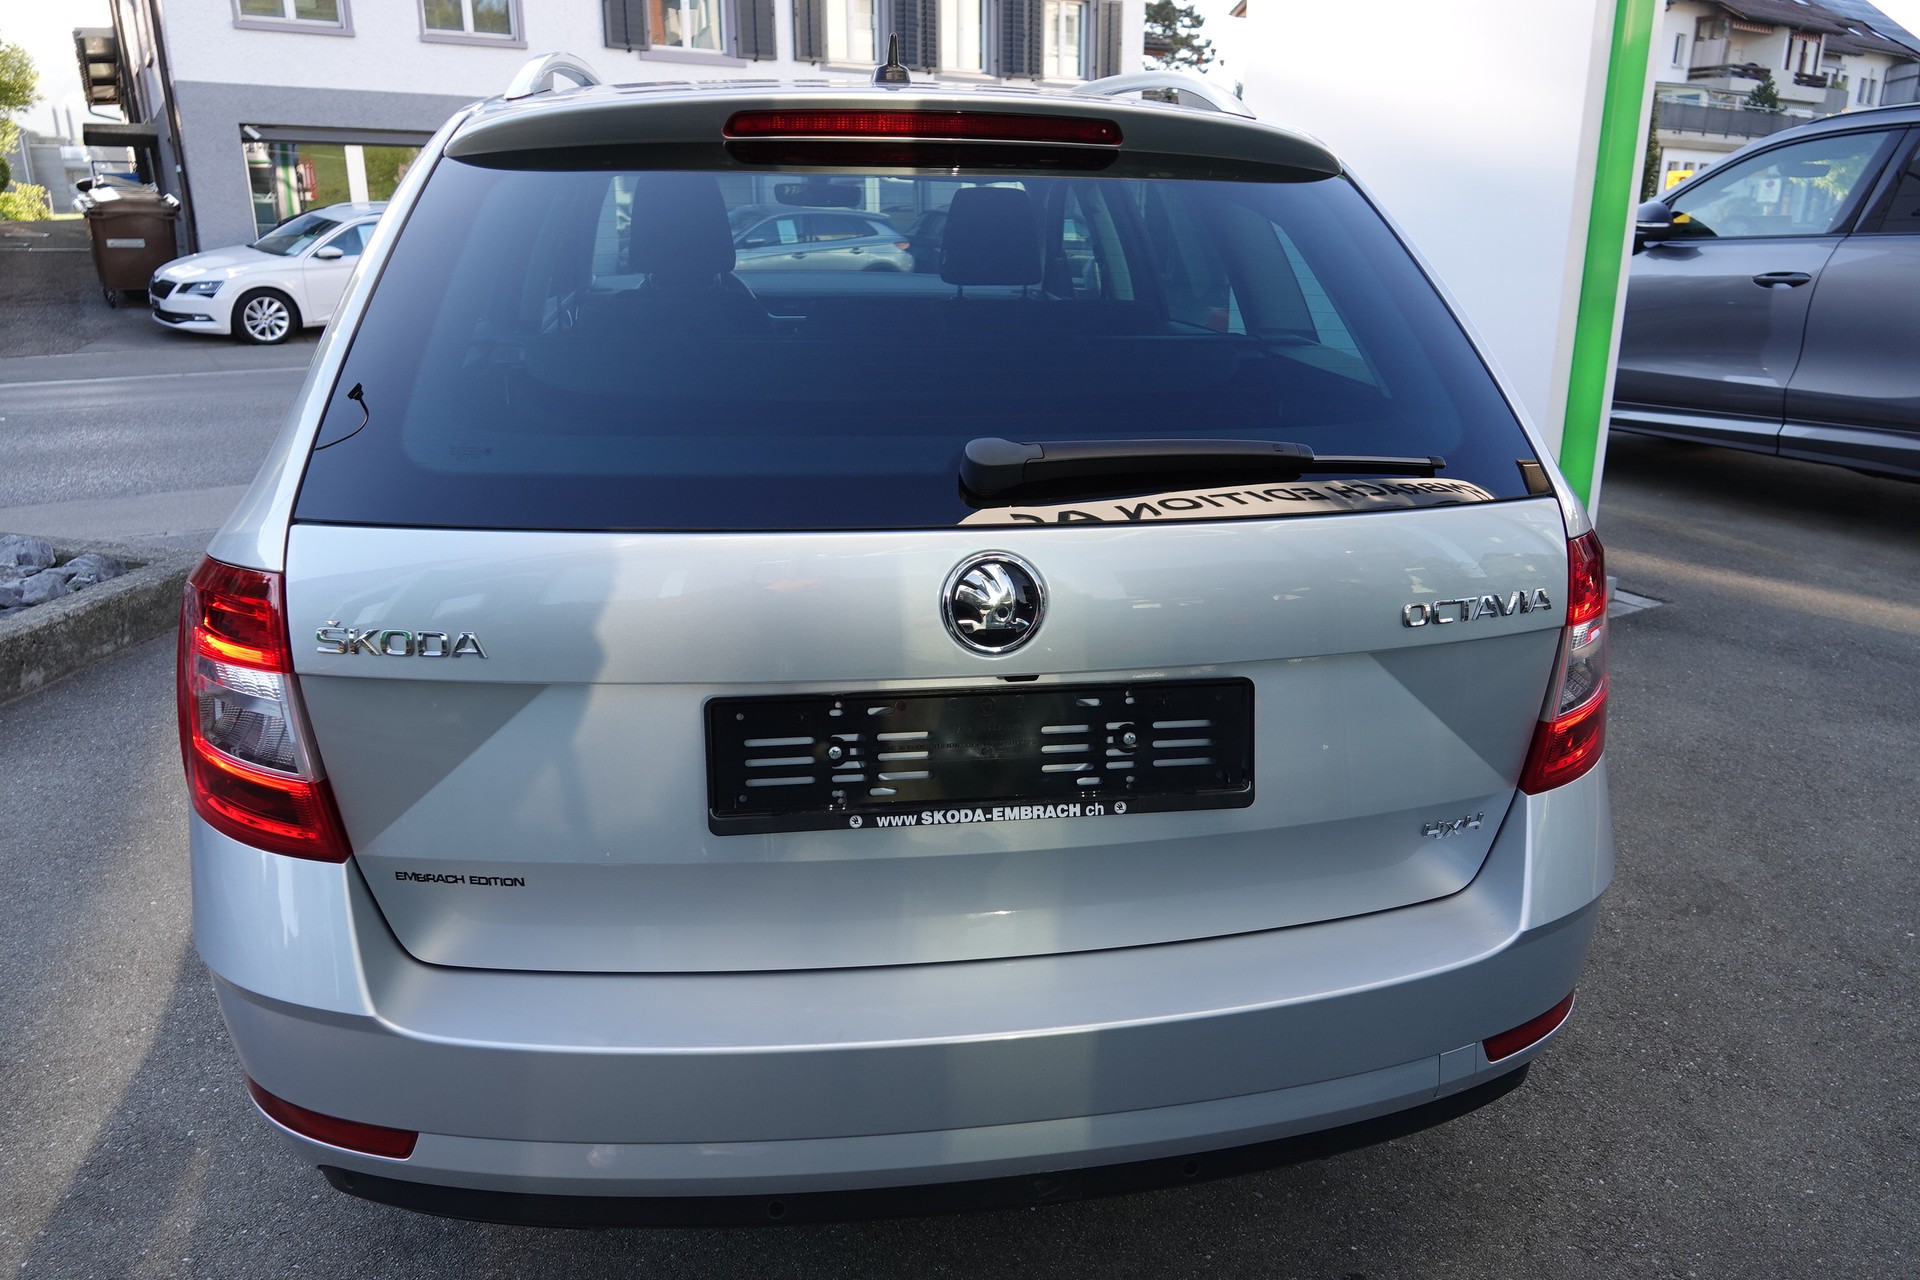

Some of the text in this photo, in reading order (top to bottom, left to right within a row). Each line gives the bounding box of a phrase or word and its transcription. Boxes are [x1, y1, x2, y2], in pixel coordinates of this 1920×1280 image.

[1402, 587, 1552, 628] OCTAVIA
[316, 619, 489, 659] ŠKODA
[920, 803, 1081, 826] SKODA-EMBRACH
[395, 871, 526, 887] EMBRACH EDITION
